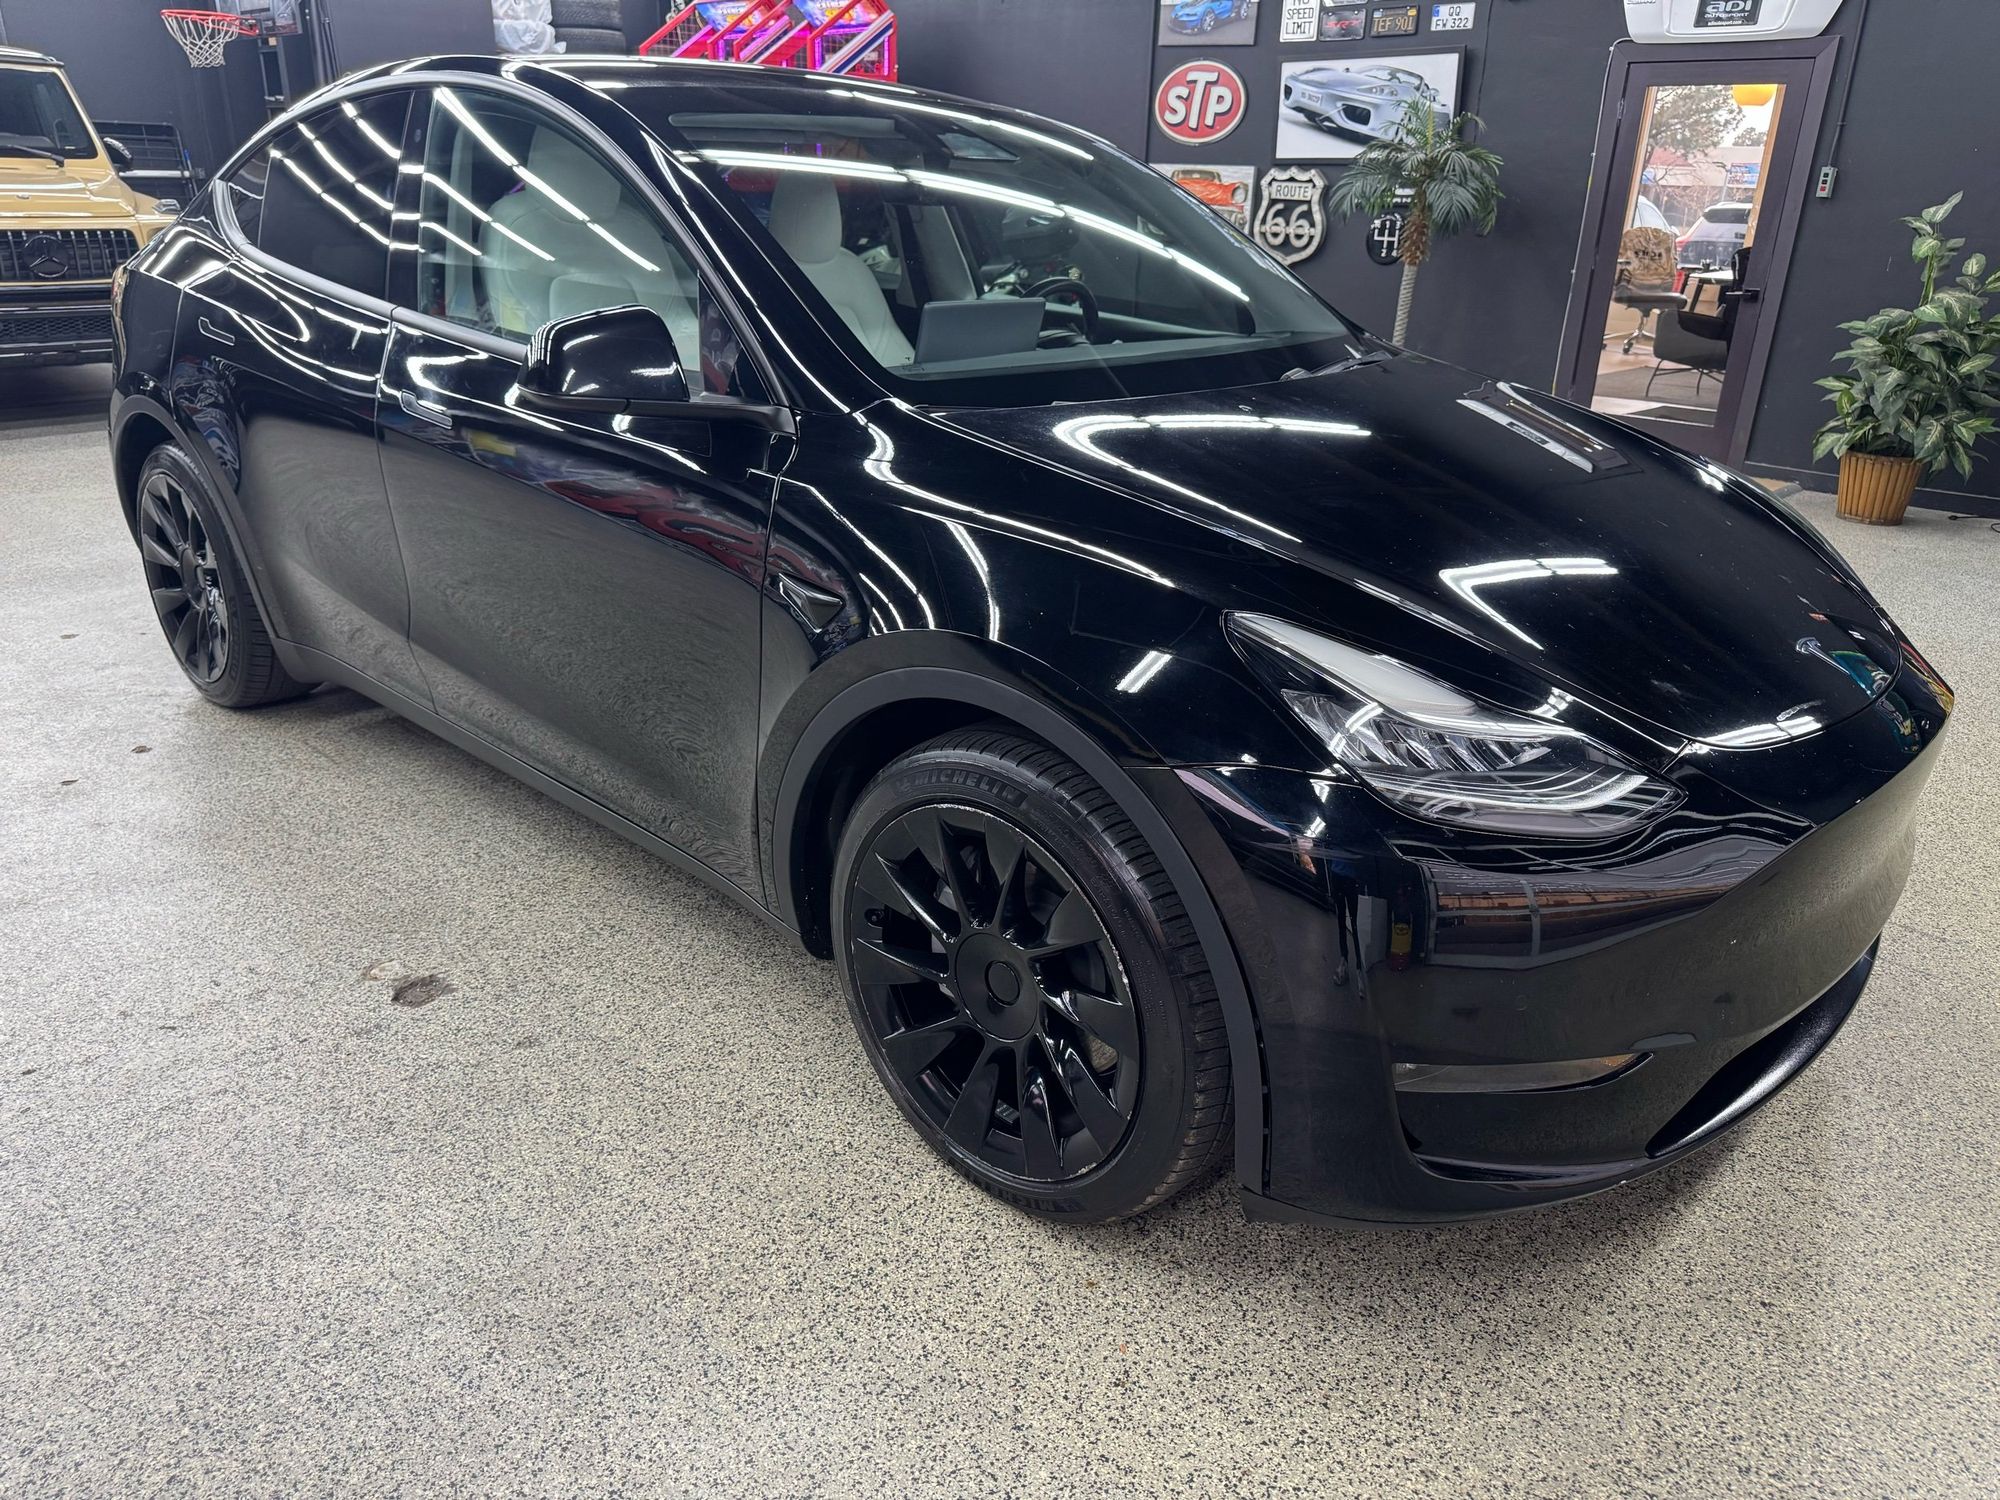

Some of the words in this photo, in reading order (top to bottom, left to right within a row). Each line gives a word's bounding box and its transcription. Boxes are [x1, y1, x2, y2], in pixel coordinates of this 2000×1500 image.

[1286, 8, 1314, 20] SPEED
[1448, 6, 1461, 16] QQ
[1286, 21, 1313, 34] LIMIT
[1373, 17, 1393, 32] TEF
[1450, 17, 1469, 29] 322
[1164, 71, 1233, 130] STP
[1275, 184, 1310, 198] ROUTE
[1265, 203, 1310, 248] 66
[915, 769, 1022, 801] MICHELIN
